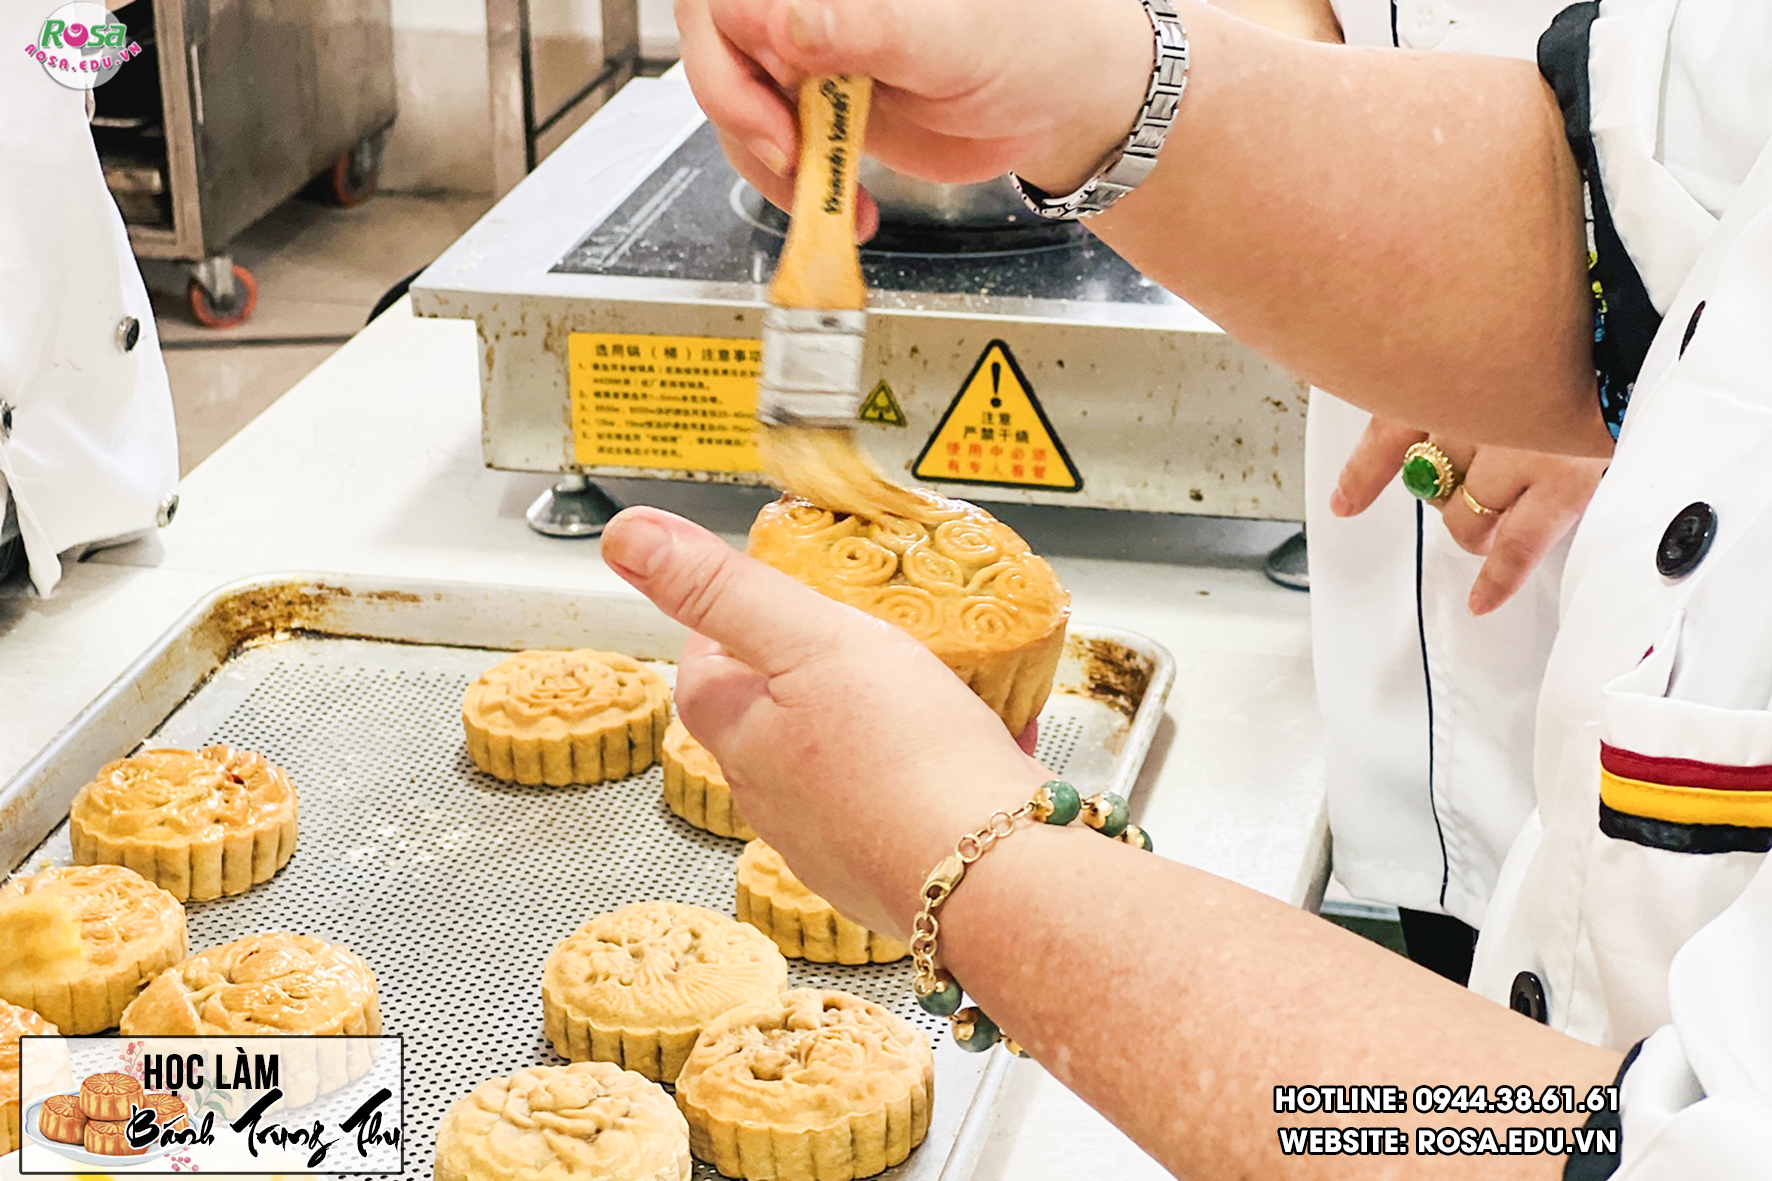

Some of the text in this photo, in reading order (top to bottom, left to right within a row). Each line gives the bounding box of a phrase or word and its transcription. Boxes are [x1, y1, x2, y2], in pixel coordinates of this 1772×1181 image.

[982, 411, 1011, 426] 注意
[963, 426, 1029, 443] 严禁干烧
